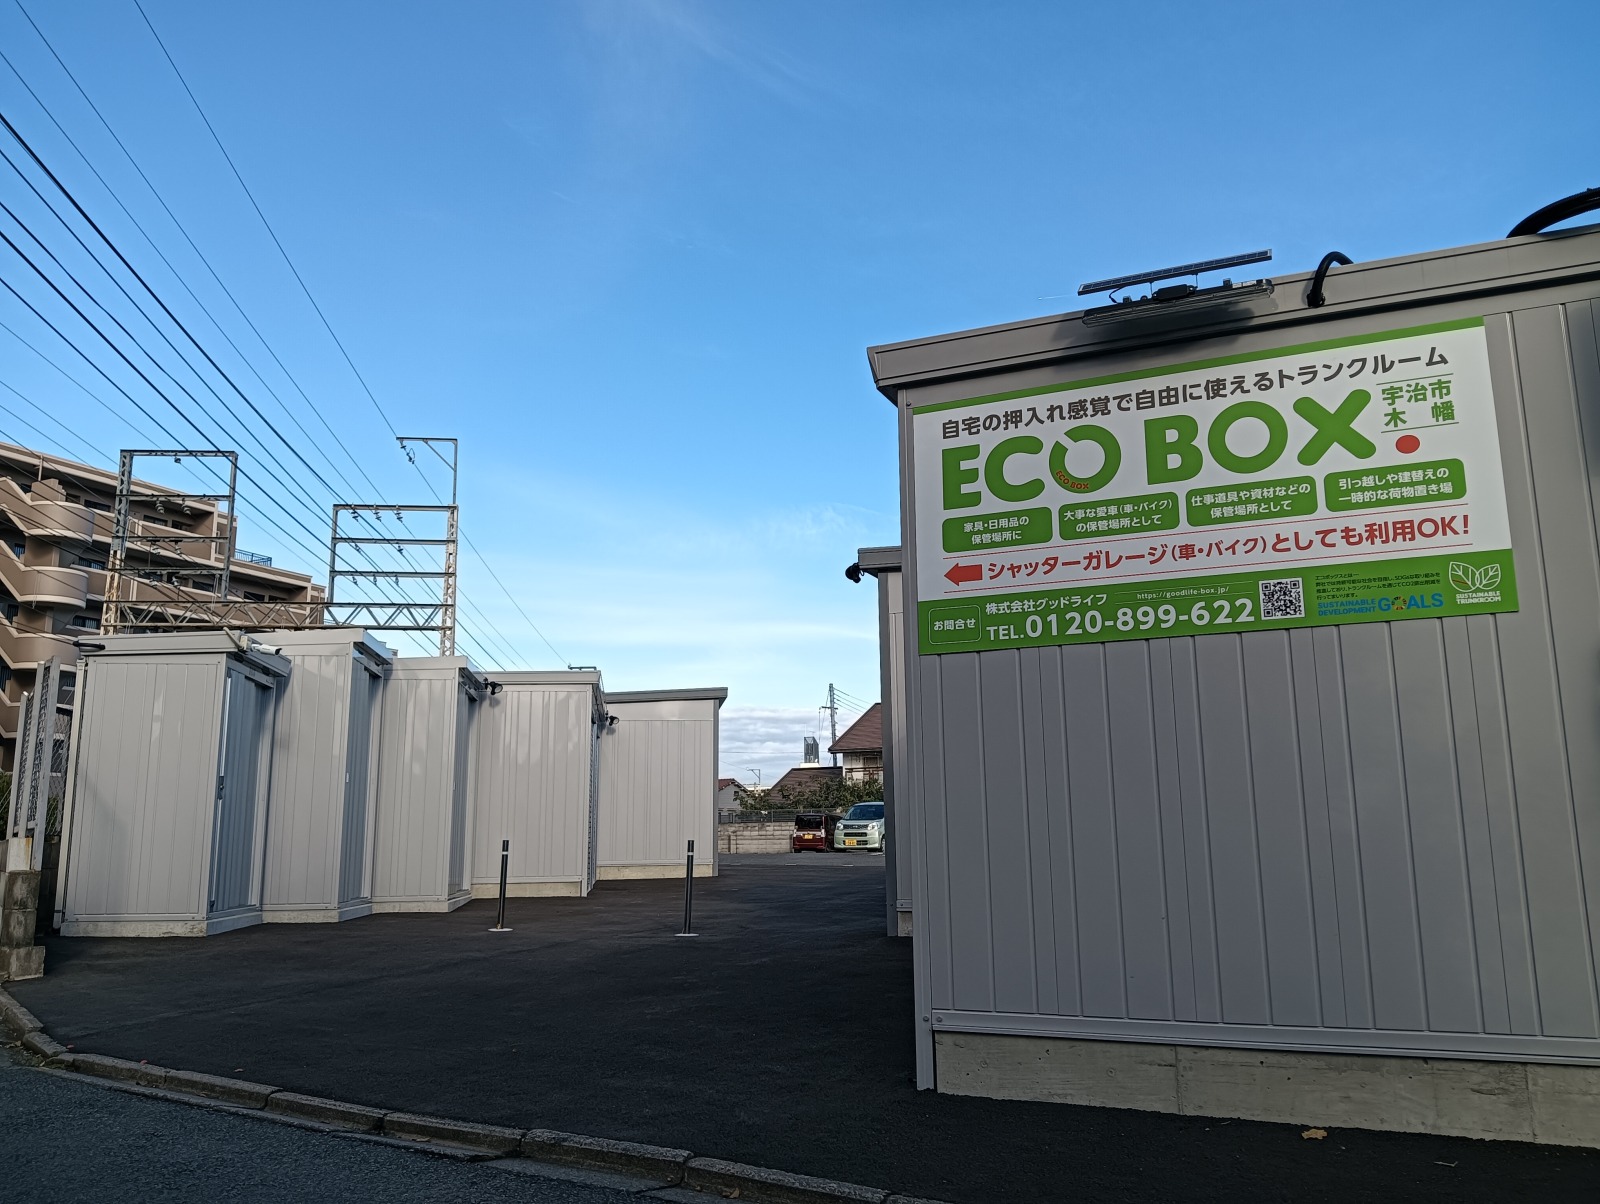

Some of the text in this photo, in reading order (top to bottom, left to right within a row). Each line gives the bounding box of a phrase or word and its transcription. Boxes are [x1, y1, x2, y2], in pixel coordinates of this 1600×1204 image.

[942, 346, 1449, 440] 自宅の押入れ感覚で自由に使えるトランクルーム
[1381, 379, 1452, 407] 宇治市
[941, 388, 1377, 510] ECO BOX
[1056, 470, 1089, 489] ECO BOX
[1338, 467, 1449, 490] 引っ越しや建替えの
[1191, 483, 1311, 507] 仕事道具や資材などの
[1338, 482, 1453, 504] 一時的な荷物置き場
[1210, 500, 1292, 519] 保管場所として
[1076, 514, 1162, 533] の保管場所として
[971, 531, 1022, 545] 保管場所に
[1136, 586, 1230, 600] https://goodlife-box.jp/
[1456, 591, 1501, 599] SUSTAINABLE
[1456, 596, 1502, 604] TRUNKROOM
[985, 593, 1107, 615] 株式会社グッドライフ
[1317, 599, 1377, 609] SUSTAINABLE
[1318, 606, 1377, 616] DEVELOPMENT
[933, 618, 976, 631] お問合せ
